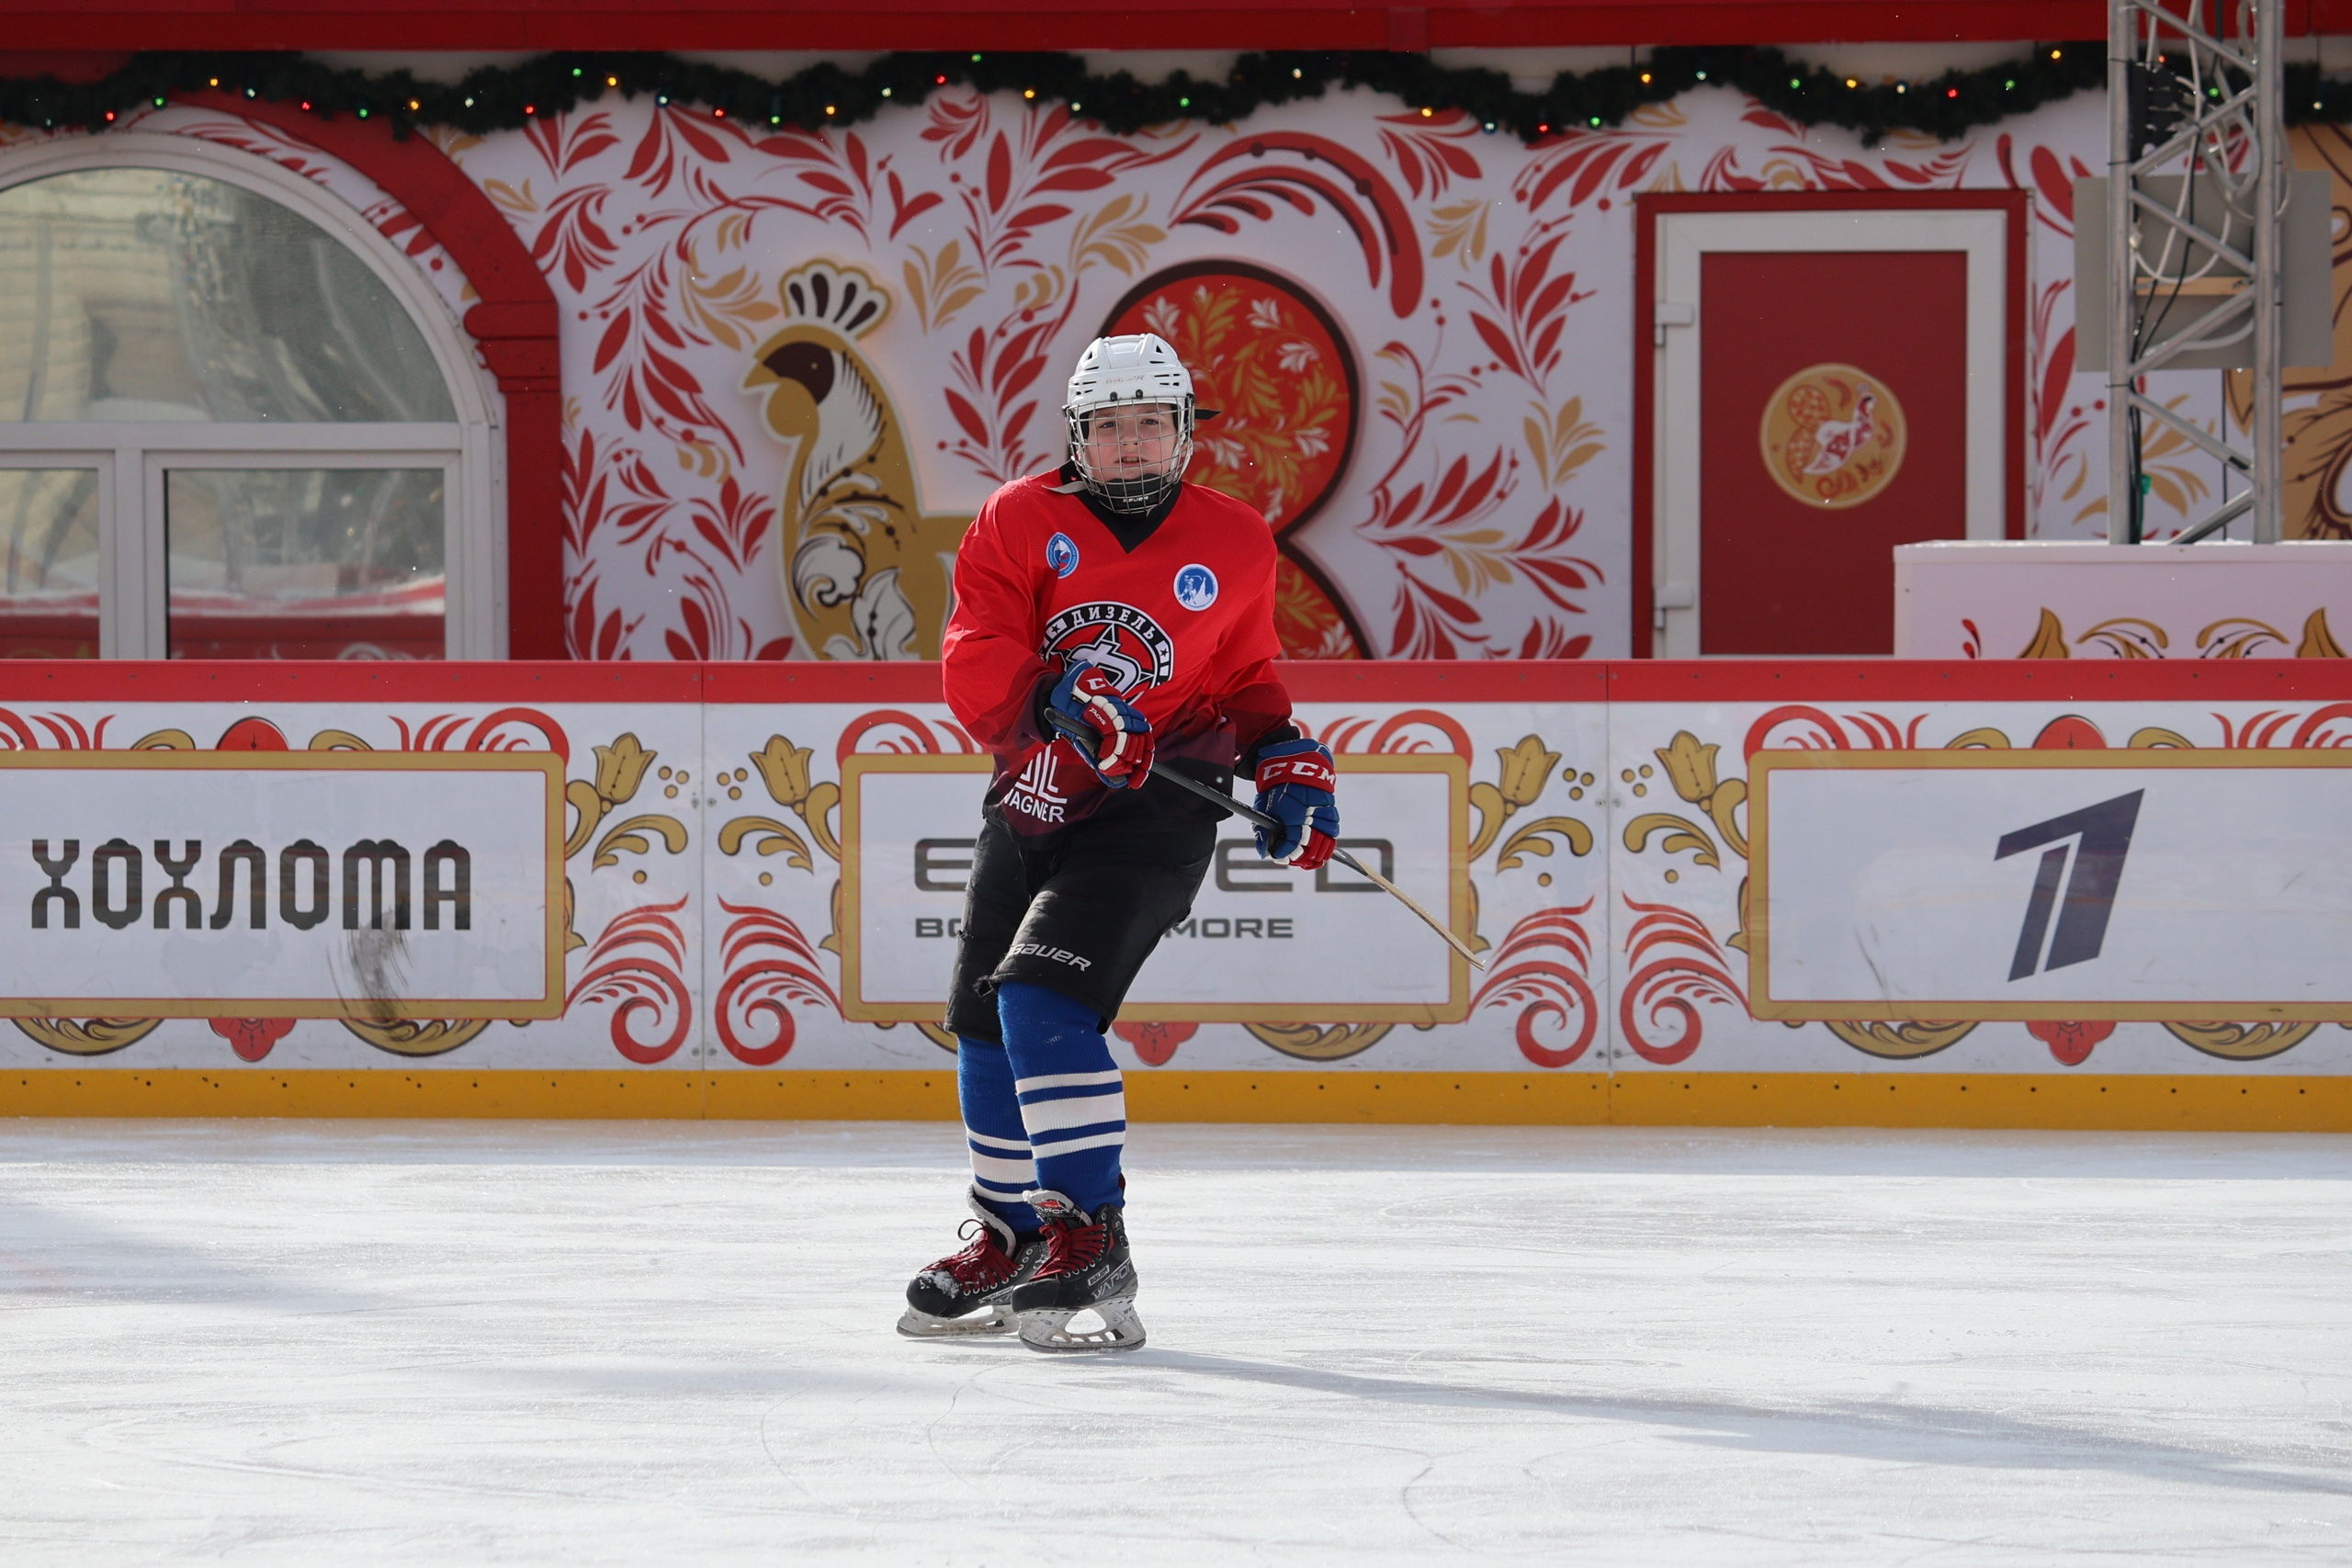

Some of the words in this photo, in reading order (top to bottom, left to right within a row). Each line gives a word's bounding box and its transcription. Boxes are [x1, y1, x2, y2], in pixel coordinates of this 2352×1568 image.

[1071, 605, 1156, 639] ДИЗЕЛЬ
[1262, 761, 1336, 784] CCM
[31, 838, 471, 930] ХОХЛОМА
[915, 838, 1394, 892] EED
